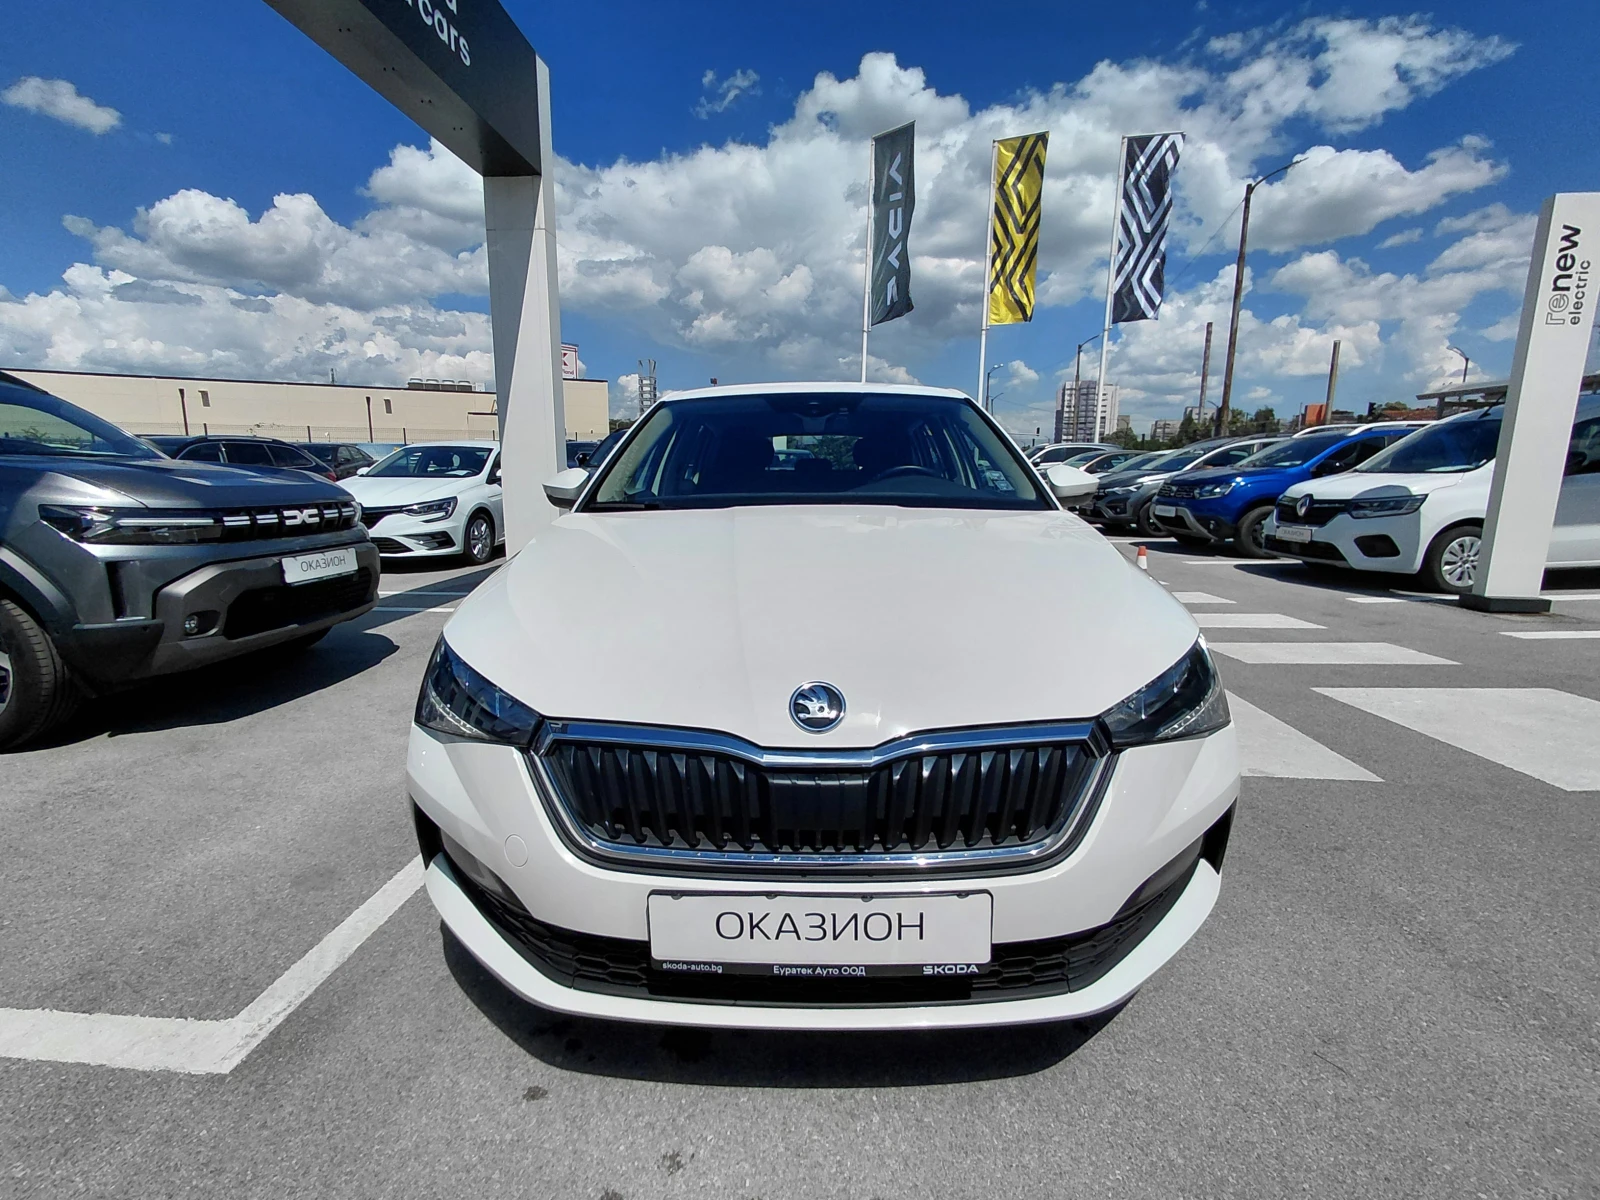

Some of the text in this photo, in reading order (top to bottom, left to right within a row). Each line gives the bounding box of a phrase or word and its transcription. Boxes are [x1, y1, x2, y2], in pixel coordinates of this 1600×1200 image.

[418, 0, 470, 67] cars
[1545, 224, 1582, 325] renew
[1568, 260, 1591, 326] electric
[300, 555, 346, 573] ОКАЗИОН
[715, 911, 924, 942] ОКАЗИОН
[662, 962, 723, 973] skoda-auto.bg
[773, 965, 866, 976] Еуратек Ауто ООД
